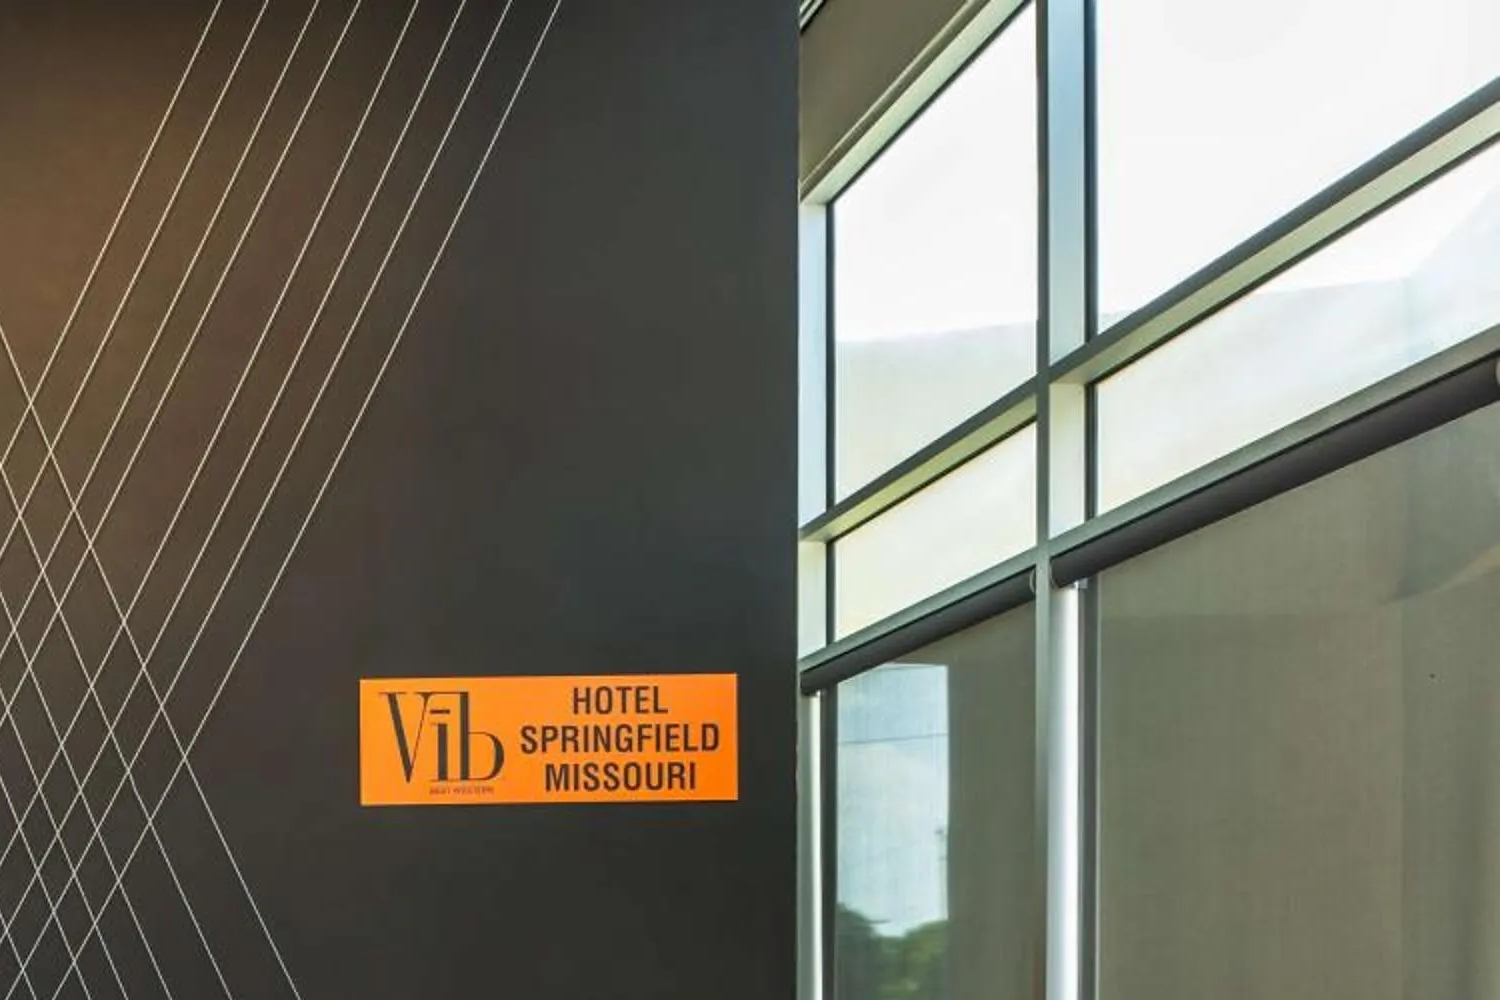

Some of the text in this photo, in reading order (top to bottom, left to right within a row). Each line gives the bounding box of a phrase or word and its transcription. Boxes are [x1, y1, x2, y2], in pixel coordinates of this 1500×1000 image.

[572, 685, 669, 715] HOTEL
[519, 723, 720, 755] SPRINGFIELD
[544, 762, 697, 792] MISSOURI
